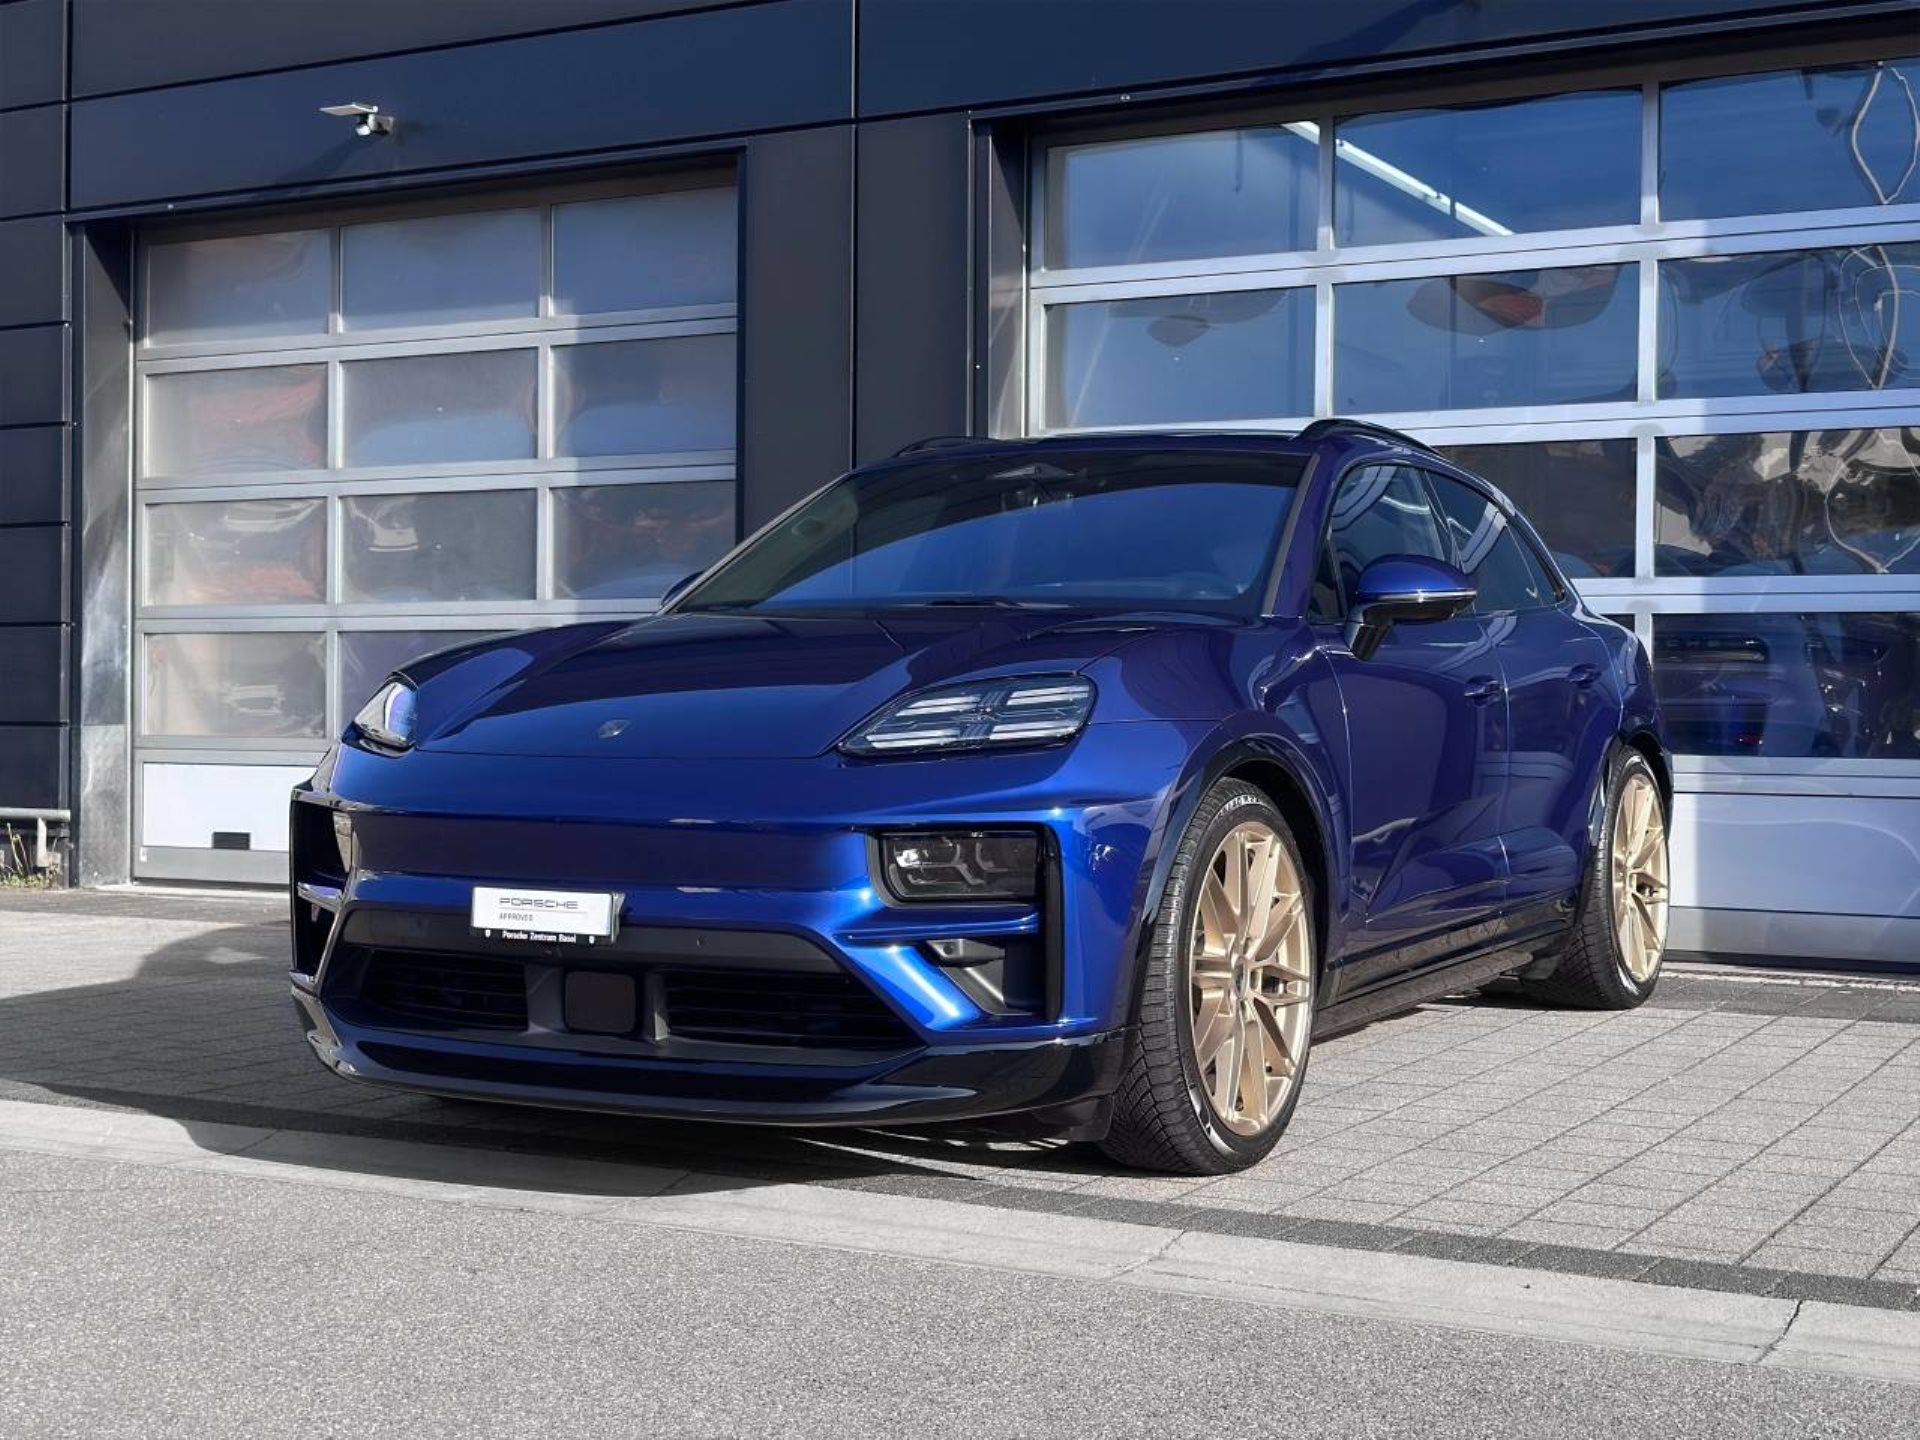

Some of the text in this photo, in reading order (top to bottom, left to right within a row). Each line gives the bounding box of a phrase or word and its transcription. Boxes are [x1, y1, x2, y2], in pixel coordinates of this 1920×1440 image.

[499, 897, 578, 910] PORSCHE
[498, 912, 534, 922] APPROVED
[502, 930, 577, 944] Porsche Zentrum Basel
